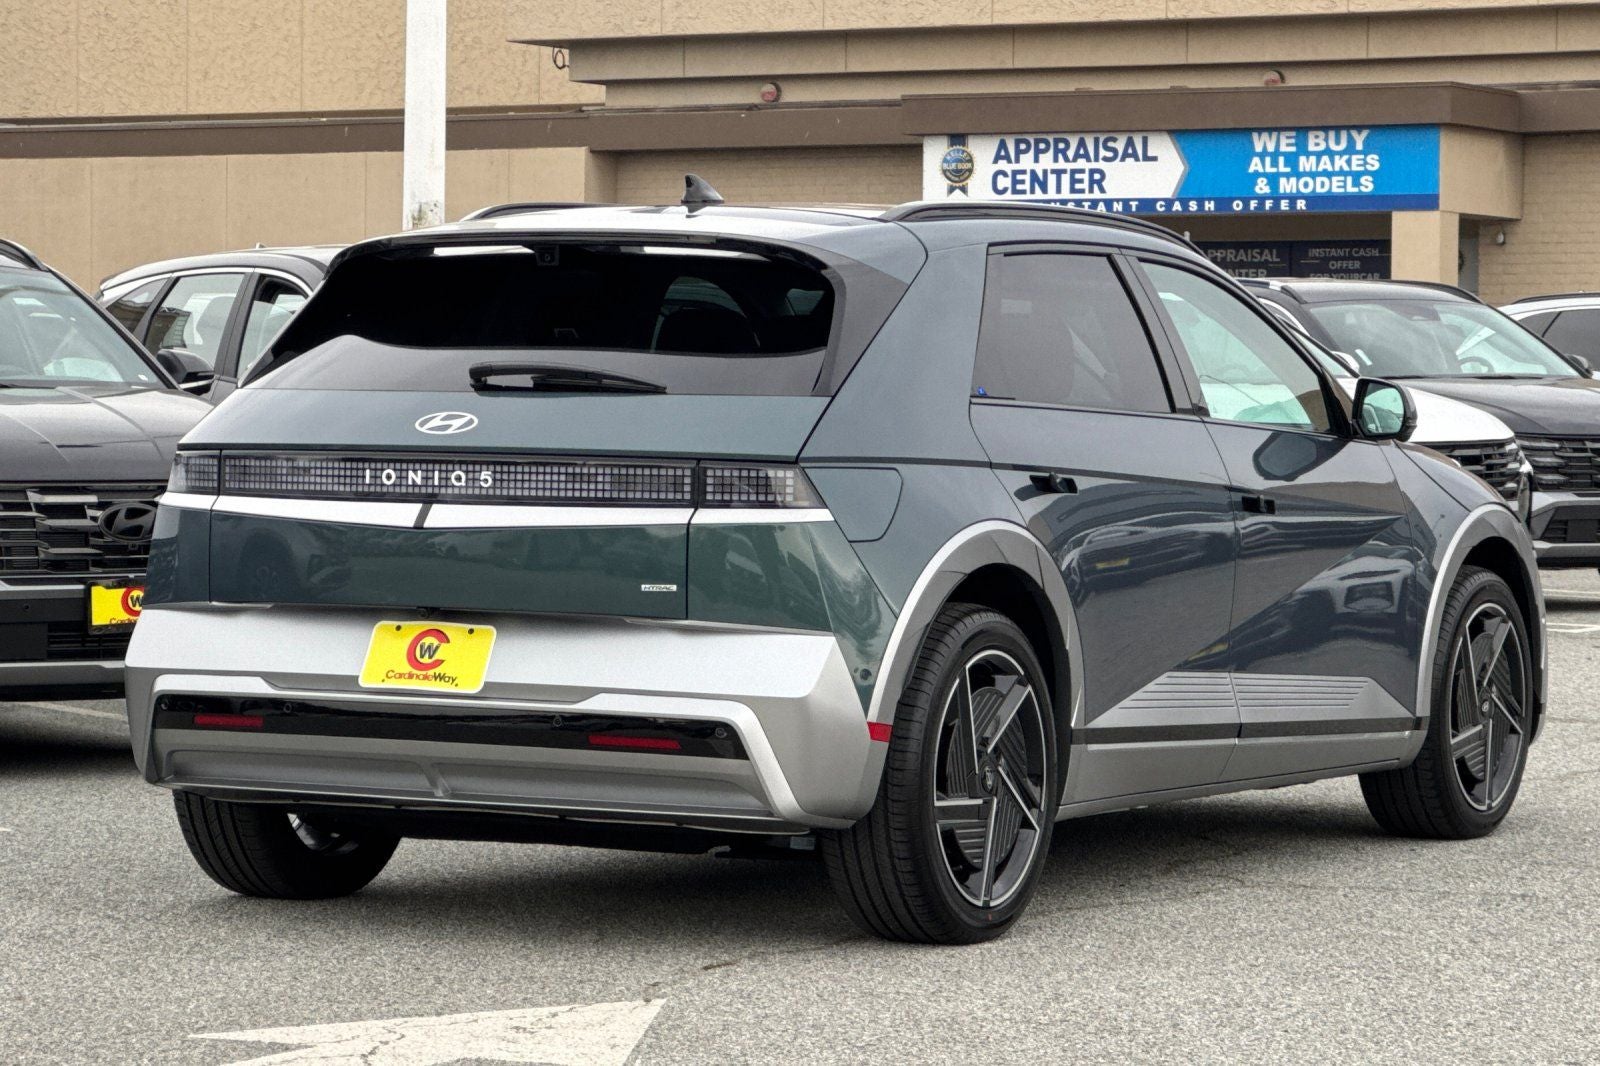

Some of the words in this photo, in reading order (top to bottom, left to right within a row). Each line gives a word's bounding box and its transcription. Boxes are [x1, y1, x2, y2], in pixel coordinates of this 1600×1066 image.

[992, 136, 1158, 165] APPRAISAL
[1251, 131, 1297, 153] WE
[1307, 129, 1370, 152] BUY
[1248, 156, 1291, 173] ALL
[1298, 154, 1380, 172] MAKES
[991, 168, 1107, 195] CENTER
[1254, 177, 1271, 194] &
[1279, 175, 1374, 194] MODELS
[1156, 200, 1215, 212] CASH
[1232, 199, 1307, 211] OFFER
[1206, 248, 1281, 262] PPRAISAL
[1308, 248, 1350, 257] INSTANT
[1352, 247, 1379, 257] CASH
[1328, 260, 1361, 270] OFFER
[365, 468, 466, 486] IONIQ
[479, 471, 493, 488] 5
[385, 669, 458, 684] CardinaleWay
